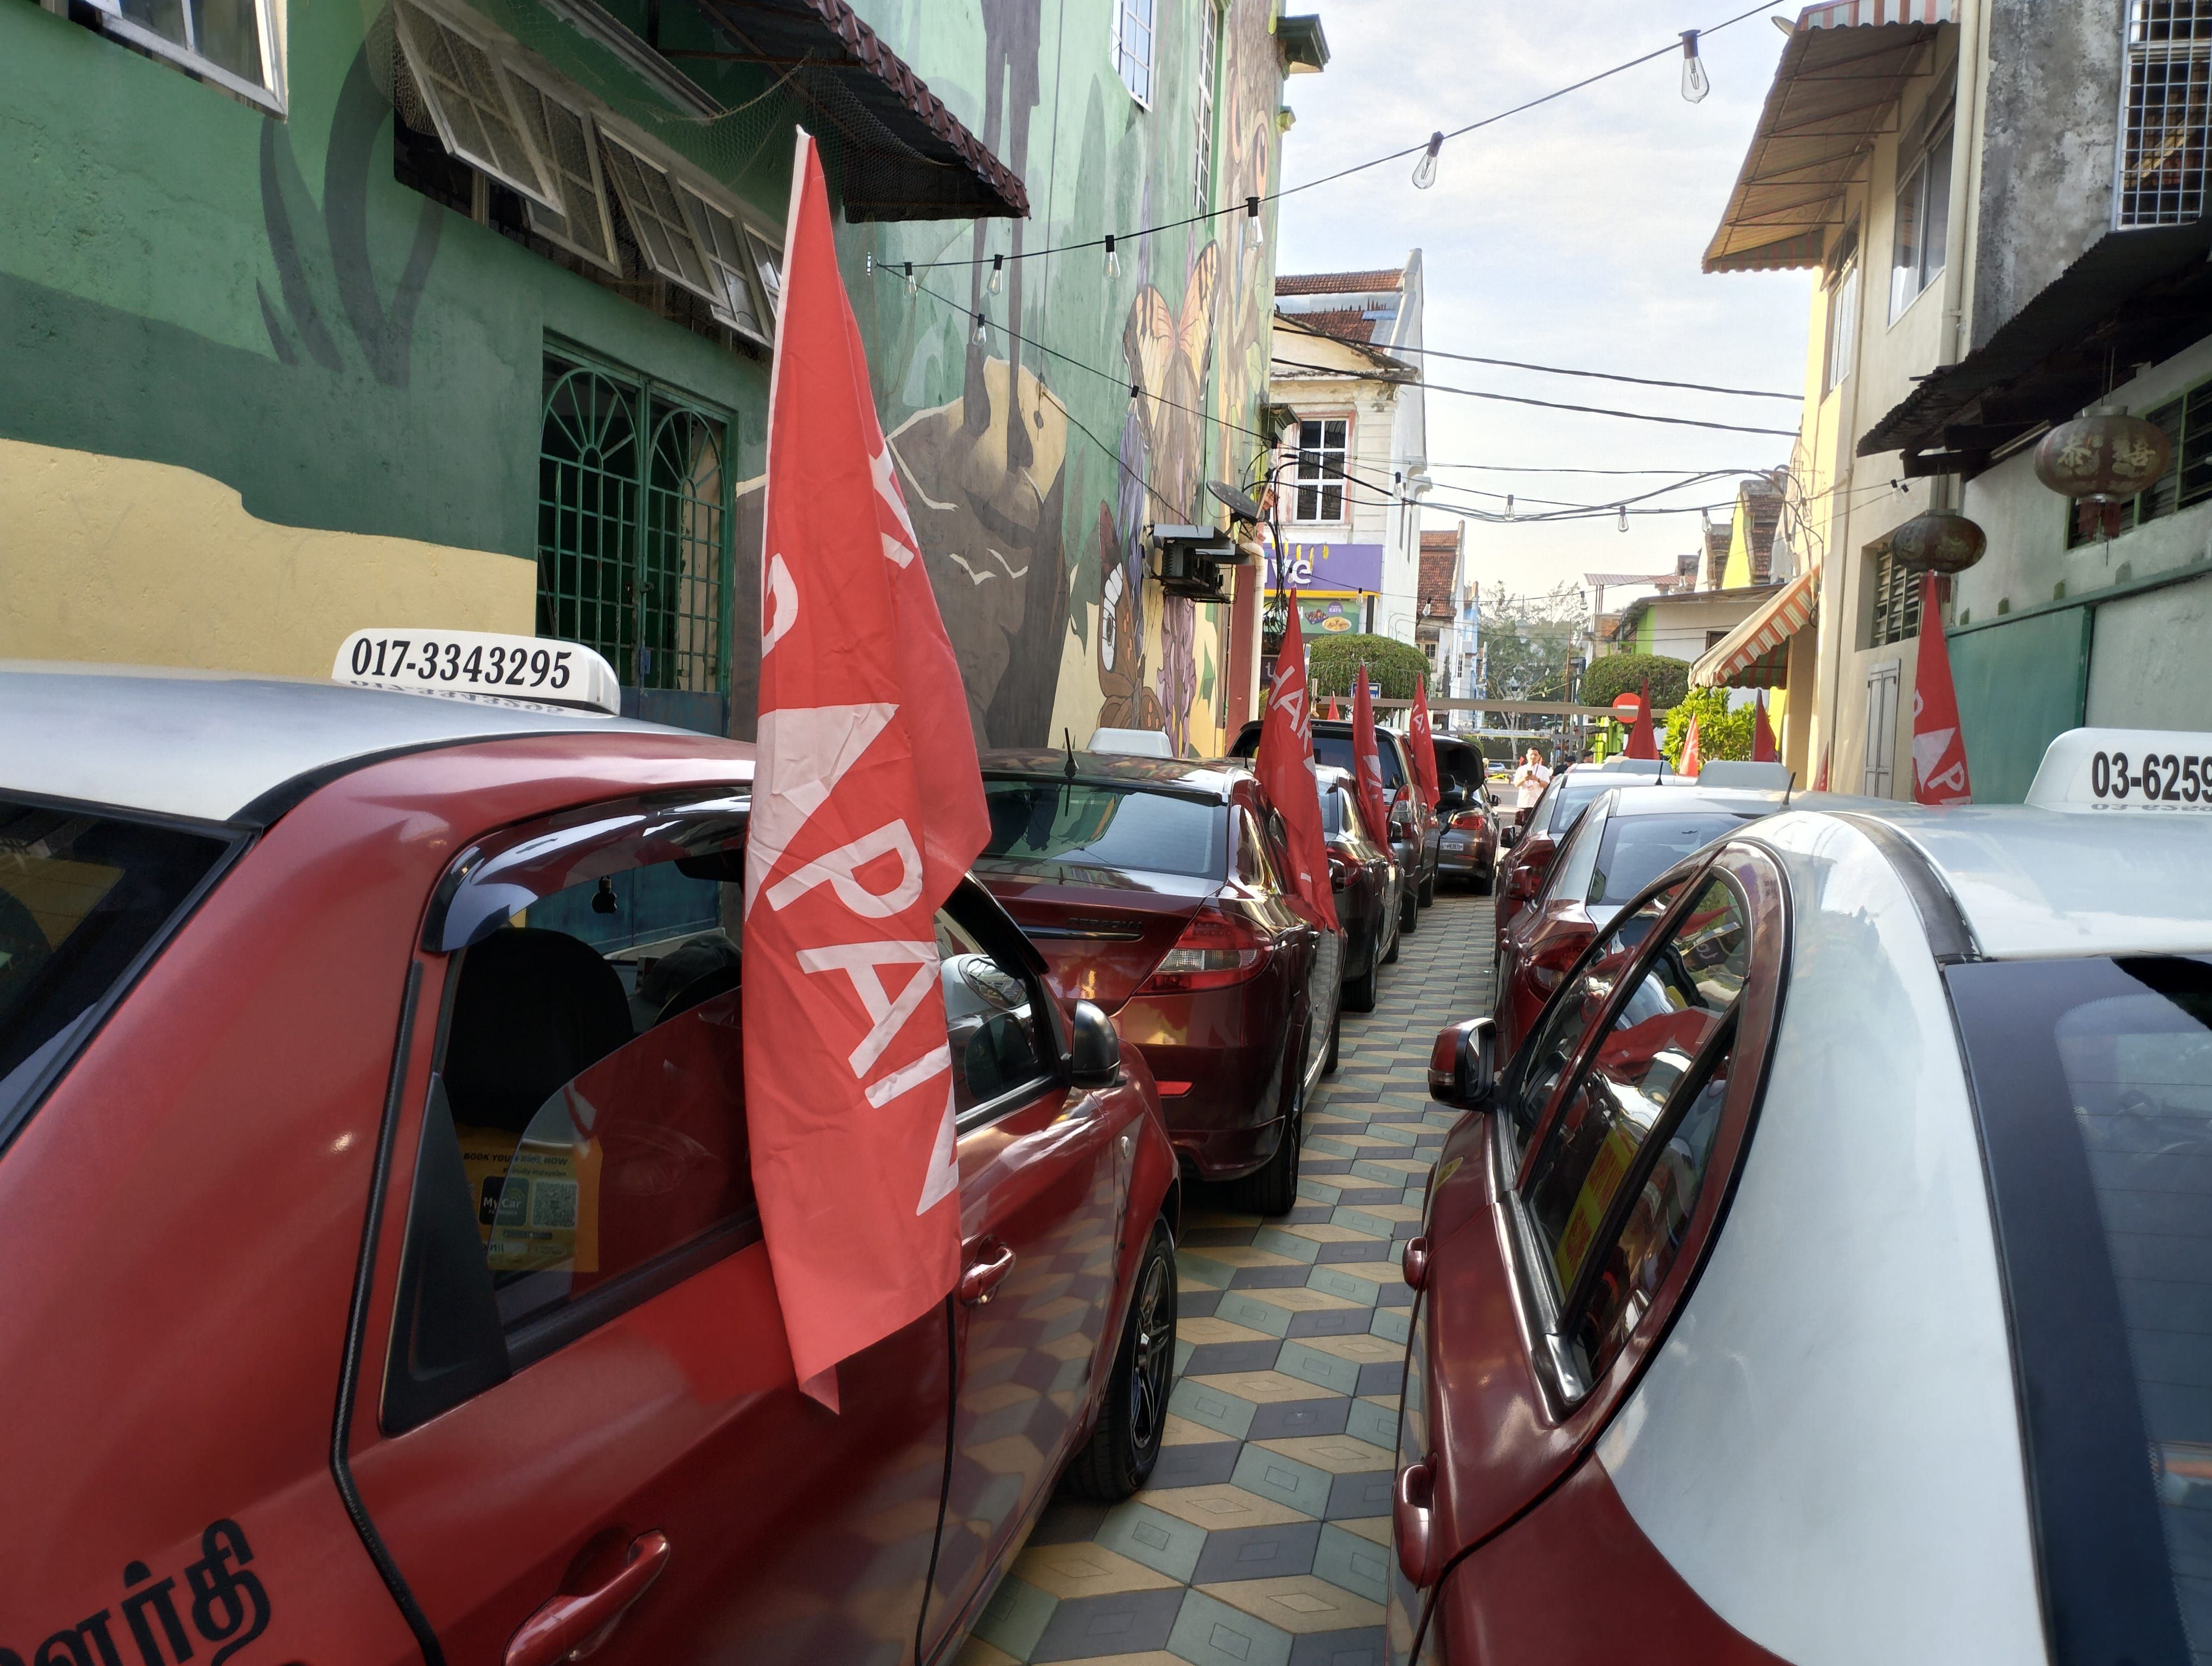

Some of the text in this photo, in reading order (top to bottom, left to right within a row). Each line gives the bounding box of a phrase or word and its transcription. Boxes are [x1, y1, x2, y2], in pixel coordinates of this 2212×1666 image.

[351, 637, 573, 689] 017-3343295
[2092, 751, 2212, 803] 03-6259
[463, 1152, 490, 1162] BOOK
[544, 1157, 568, 1165] NOW
